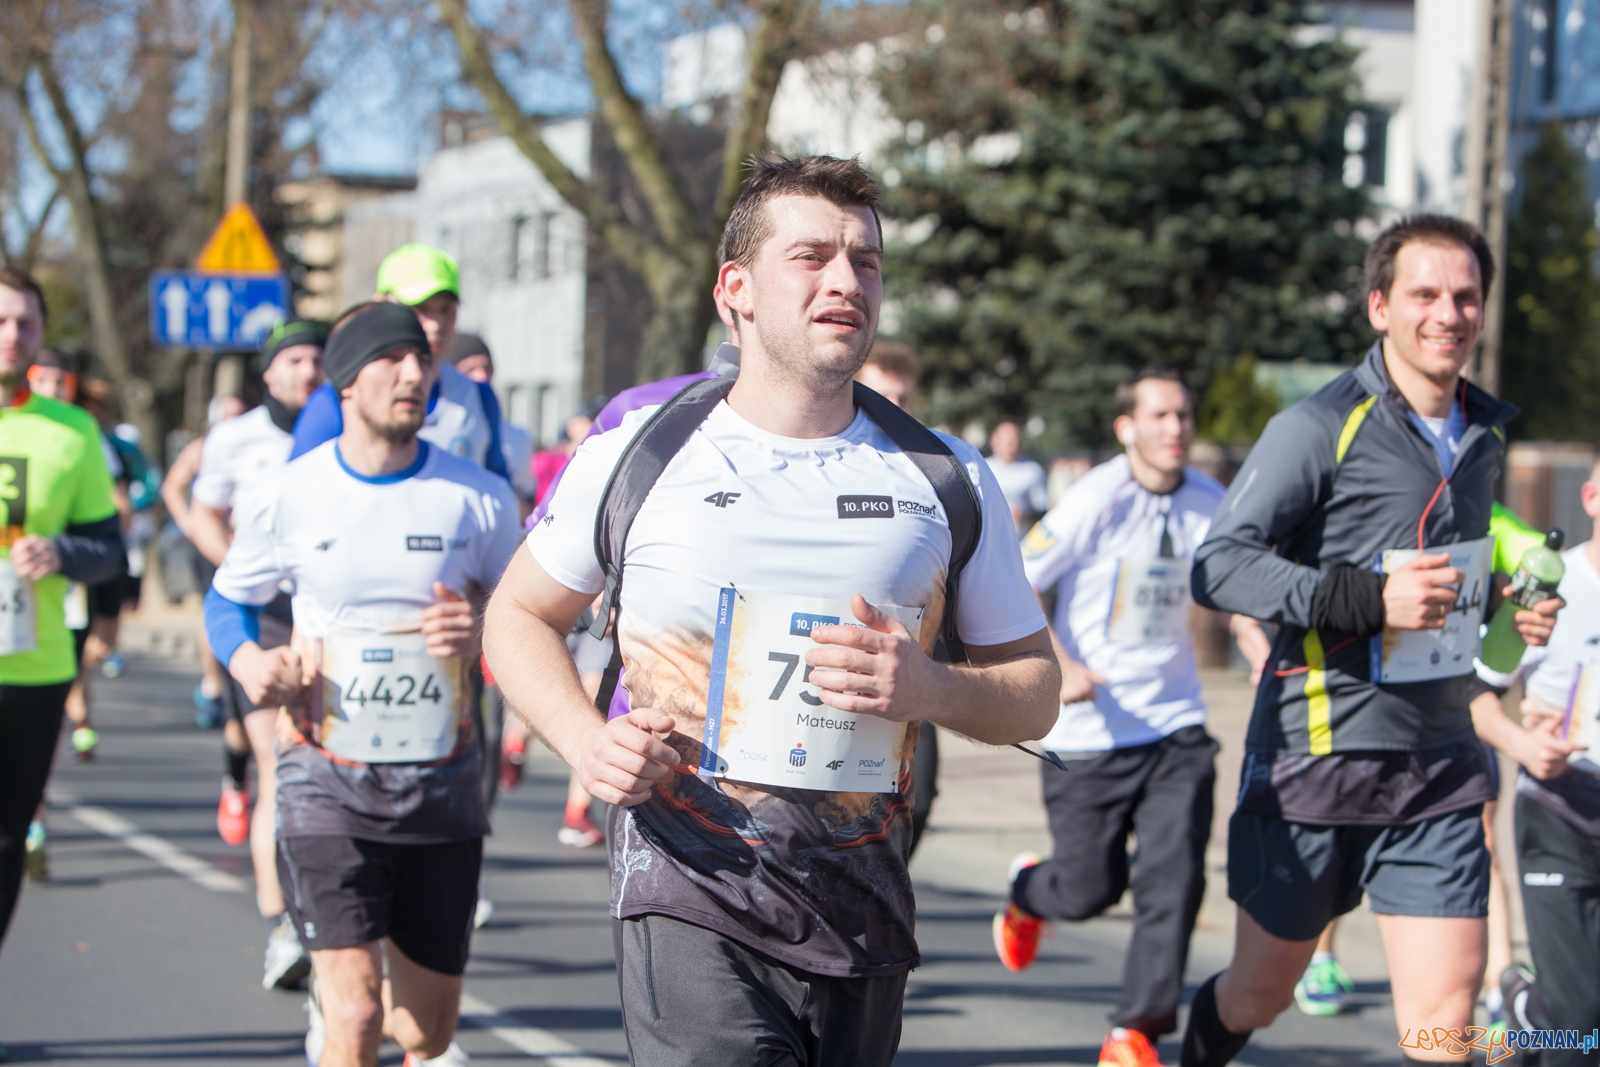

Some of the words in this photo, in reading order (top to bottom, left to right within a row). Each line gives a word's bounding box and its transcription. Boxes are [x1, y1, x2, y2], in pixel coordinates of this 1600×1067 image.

[704, 491, 741, 508] 4F
[843, 501, 860, 512] 10.
[862, 501, 889, 512] PKO
[719, 593, 729, 625] 26.03.2017
[795, 619, 810, 630] 10.
[345, 673, 442, 707] 4424
[796, 713, 856, 731] Mateusz
